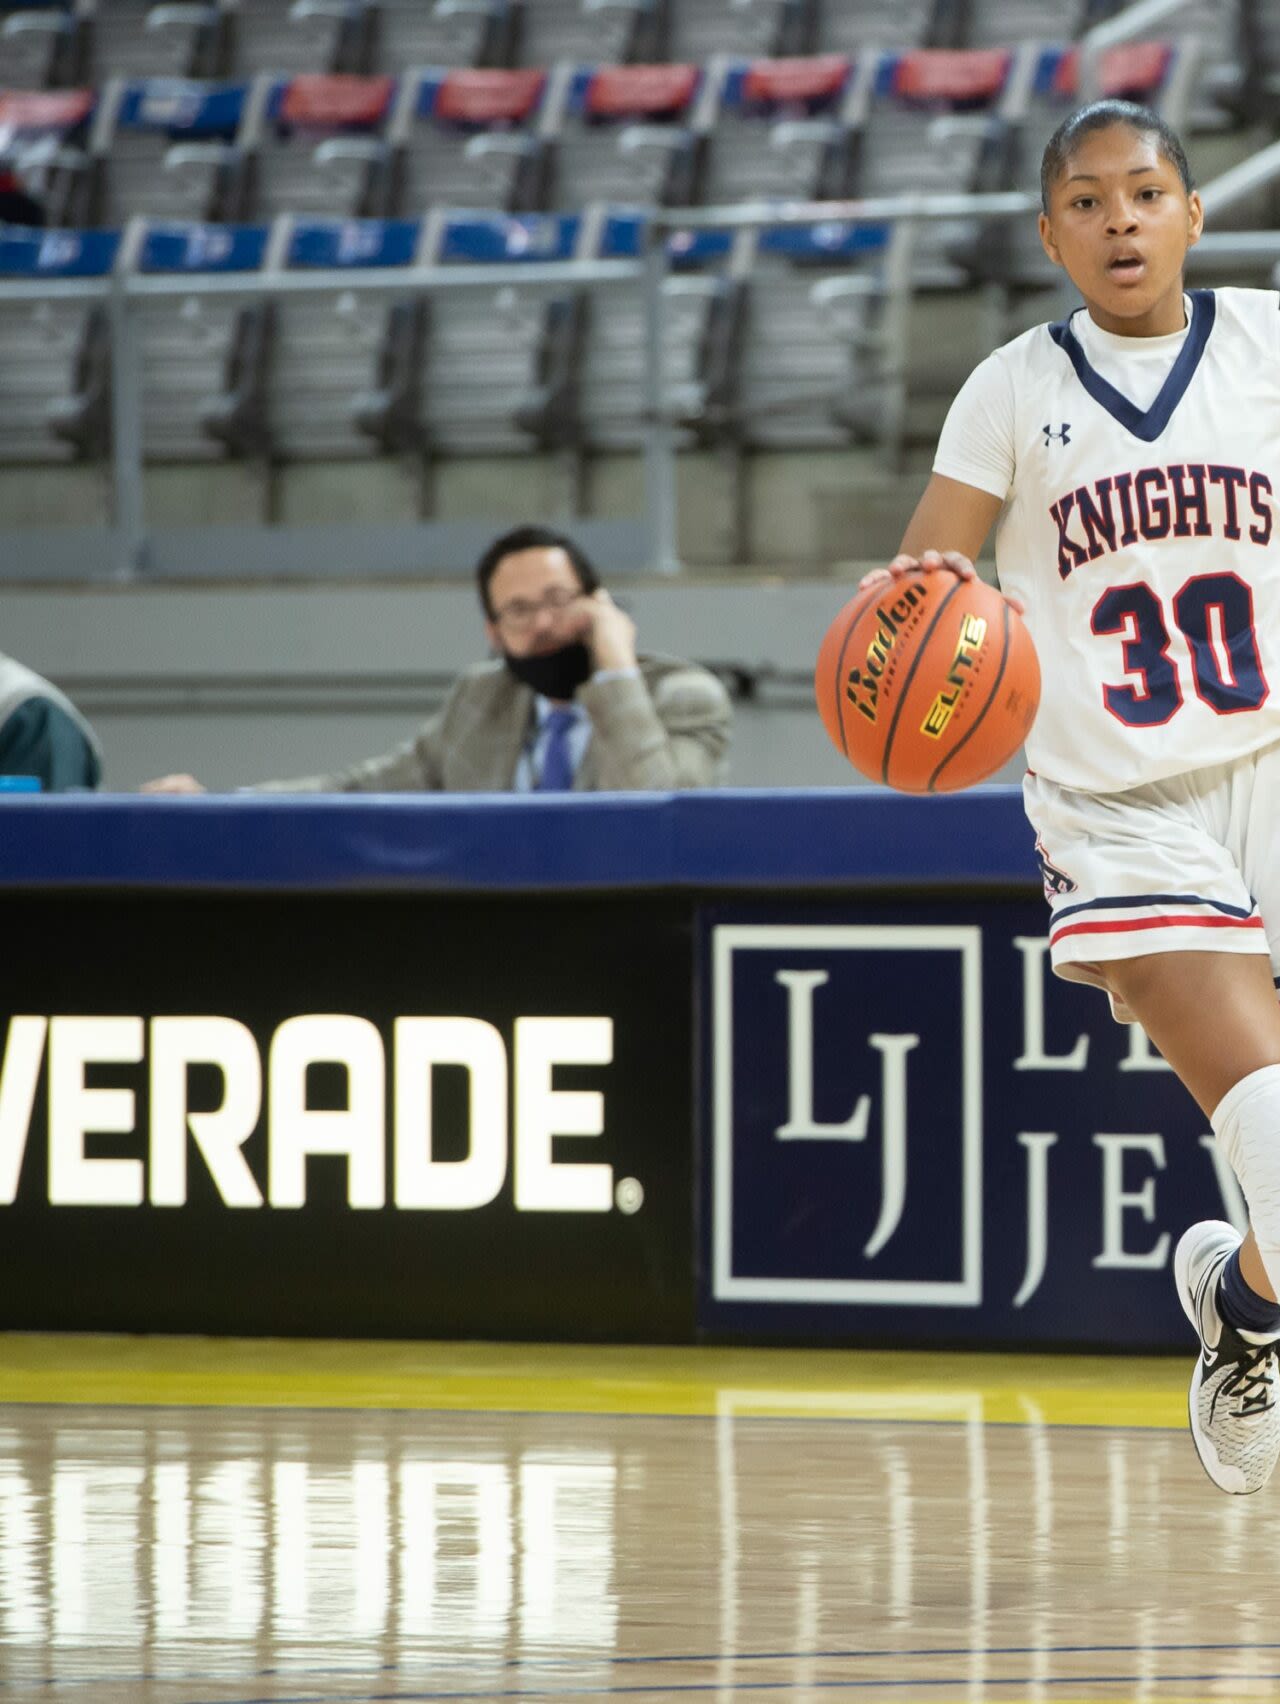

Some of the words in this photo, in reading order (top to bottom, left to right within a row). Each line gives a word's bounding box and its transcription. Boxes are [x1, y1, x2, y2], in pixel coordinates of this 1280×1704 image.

[1049, 464, 1273, 581] KNIGHTS
[846, 583, 928, 725] Baden
[919, 612, 988, 741] ELITE
[1090, 571, 1270, 727] 30
